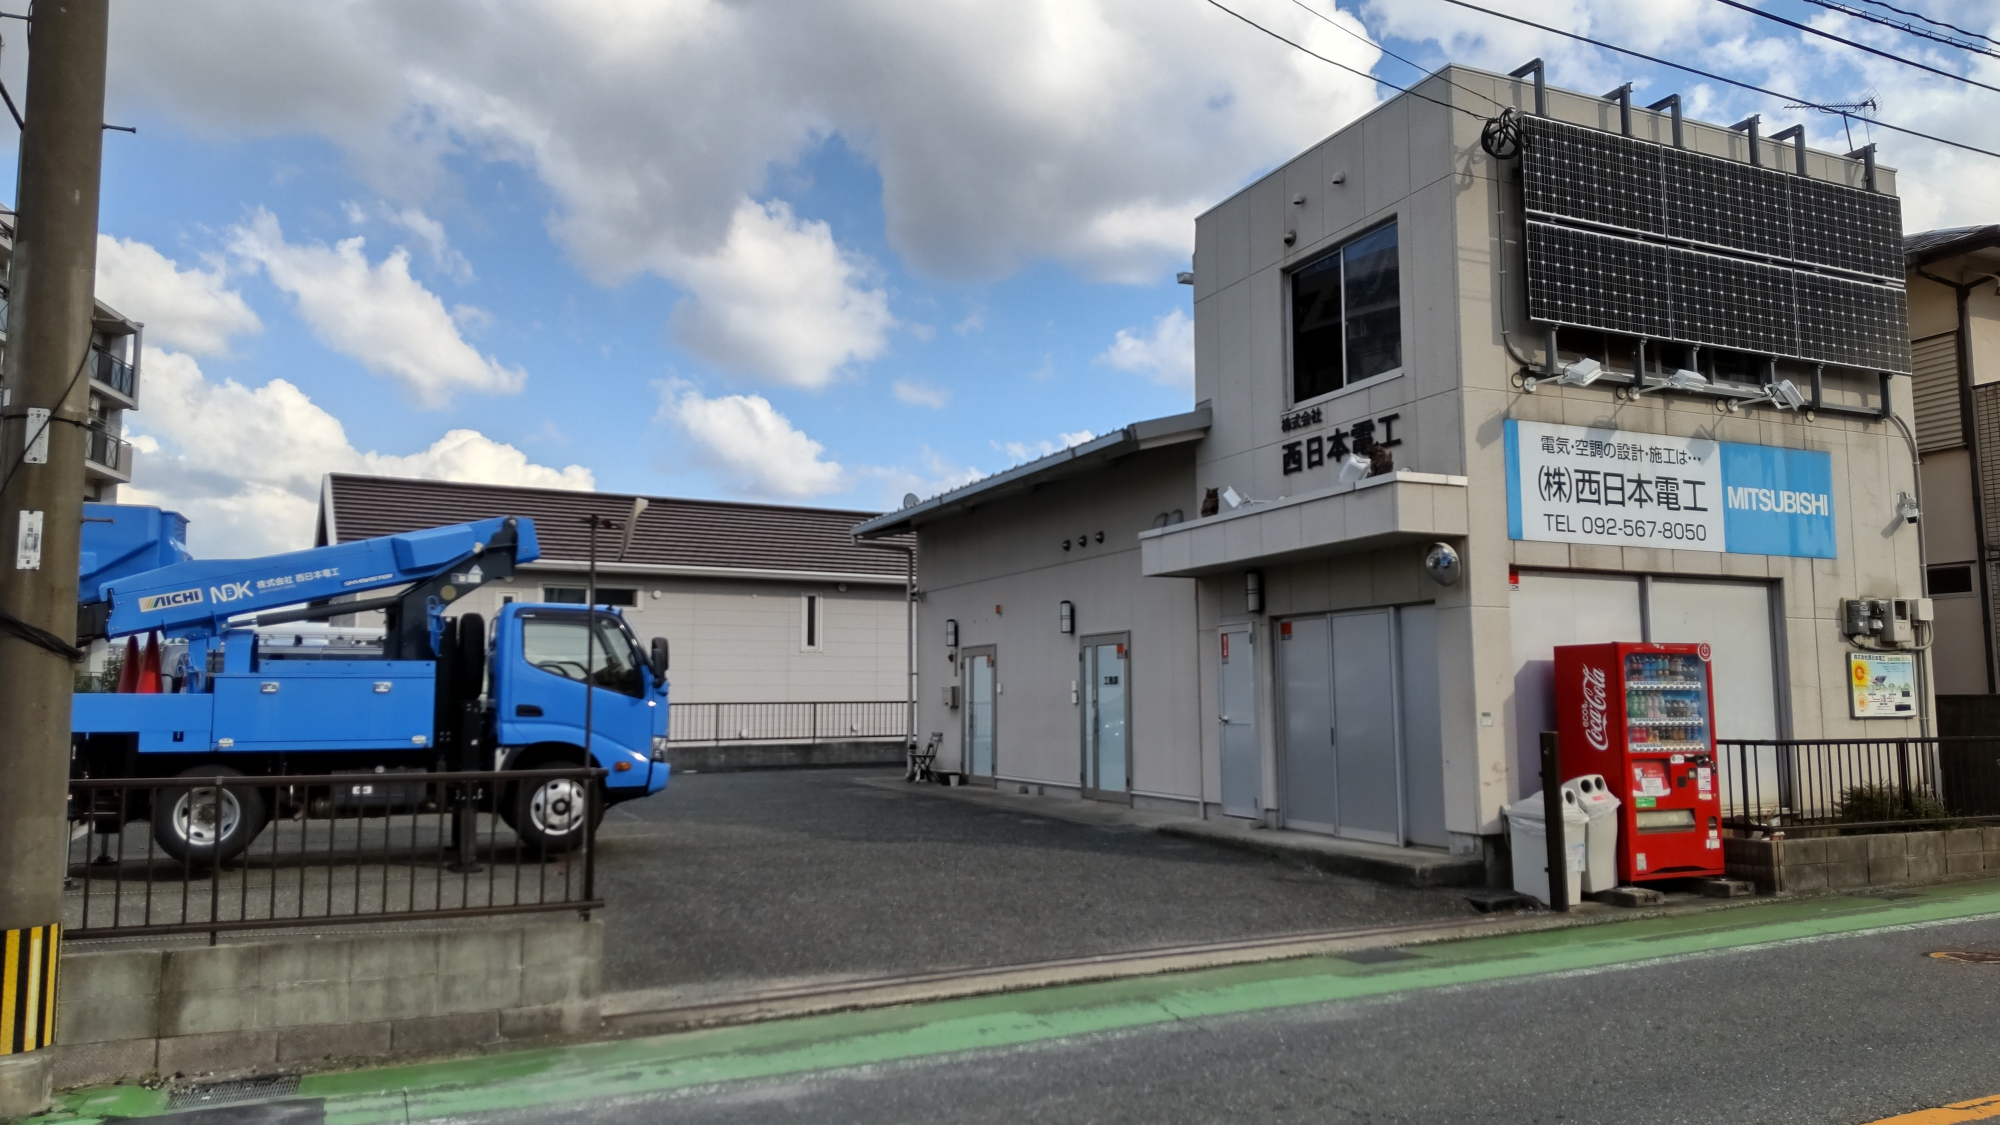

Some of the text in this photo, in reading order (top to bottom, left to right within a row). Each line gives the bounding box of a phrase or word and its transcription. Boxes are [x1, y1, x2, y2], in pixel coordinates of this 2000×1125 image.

[1281, 407, 1323, 433] 株式会社
[1282, 413, 1402, 476] 西日本電工
[1727, 486, 1829, 516] MITSUBISHI
[1543, 513, 1707, 542] TEL 092-567-8050
[210, 580, 254, 604] NDK
[256, 575, 293, 590] 株式会社
[295, 567, 340, 583] 西日本電工
[152, 590, 200, 608] AICHI
[1583, 663, 1609, 751] Coca-Cola
